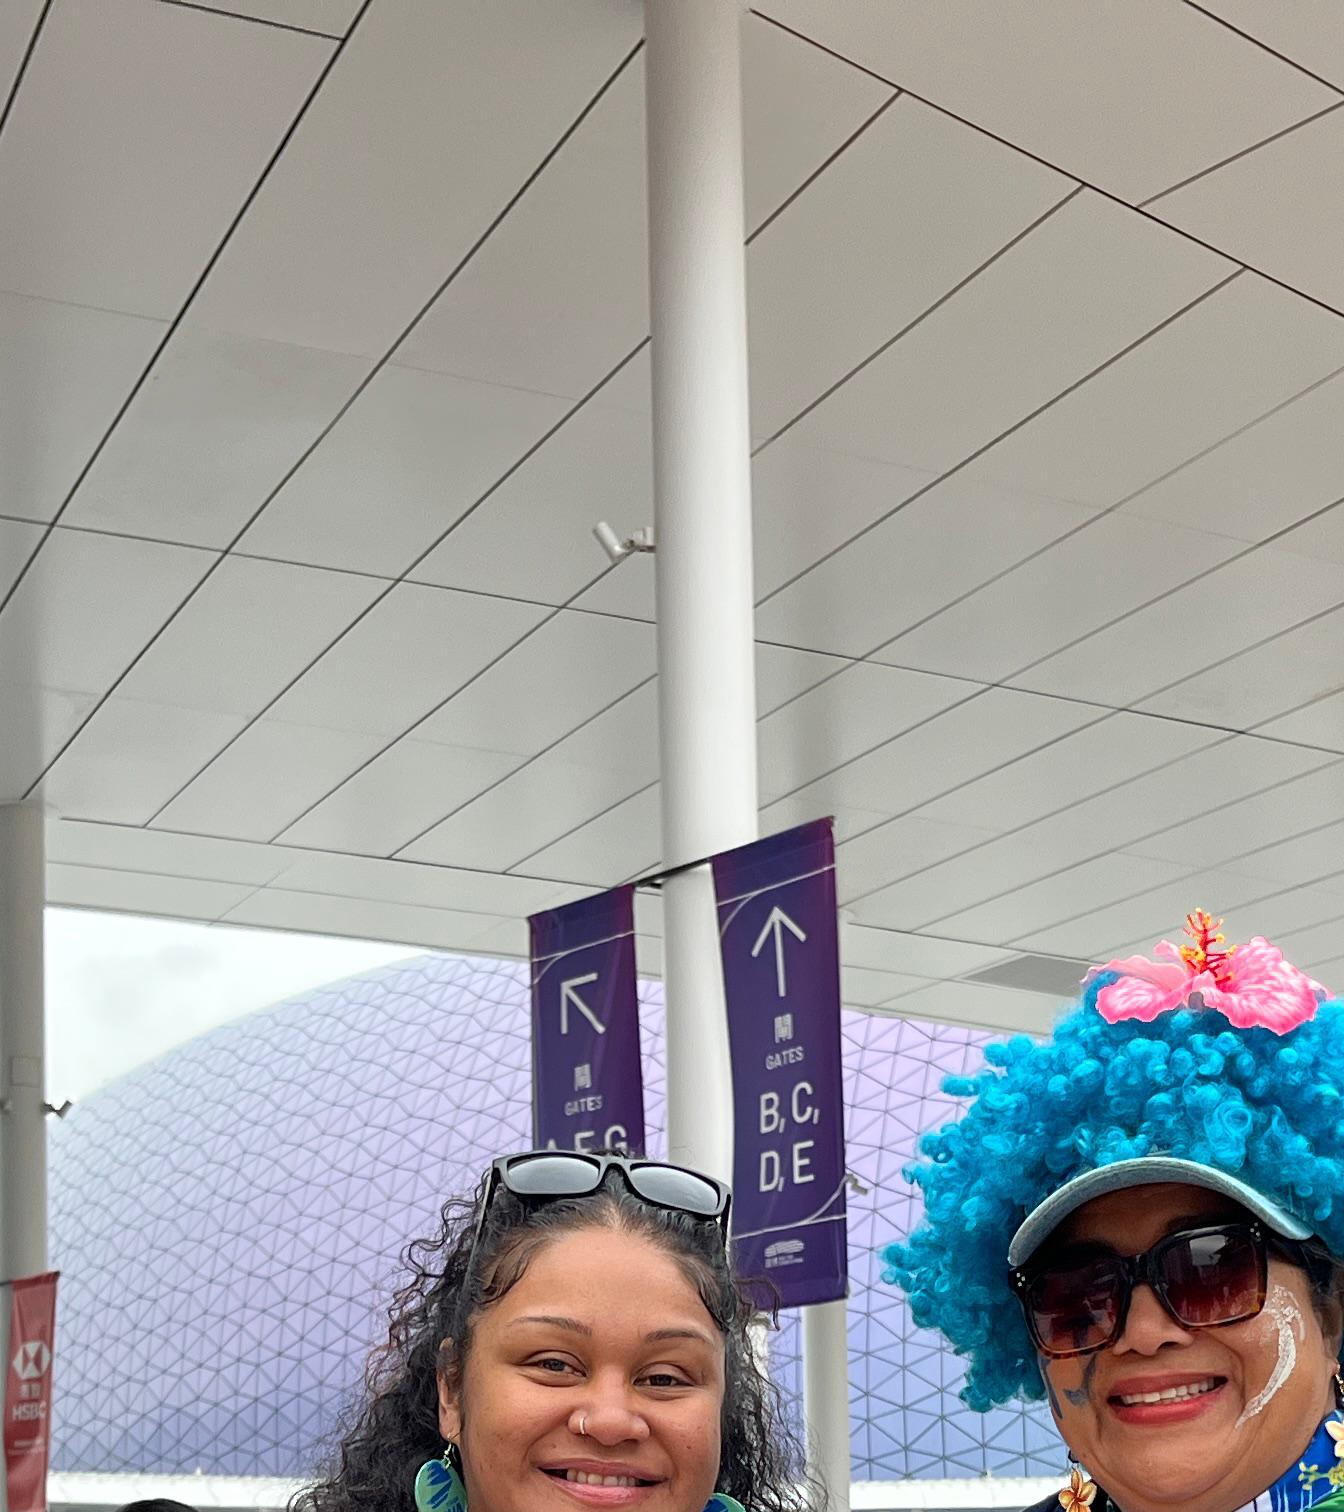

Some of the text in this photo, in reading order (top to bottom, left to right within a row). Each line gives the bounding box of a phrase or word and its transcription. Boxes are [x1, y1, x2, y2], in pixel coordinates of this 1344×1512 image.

[765, 1046, 804, 1070] GATES
[564, 1095, 603, 1117] GATES
[12, 1400, 48, 1421] HSBC
